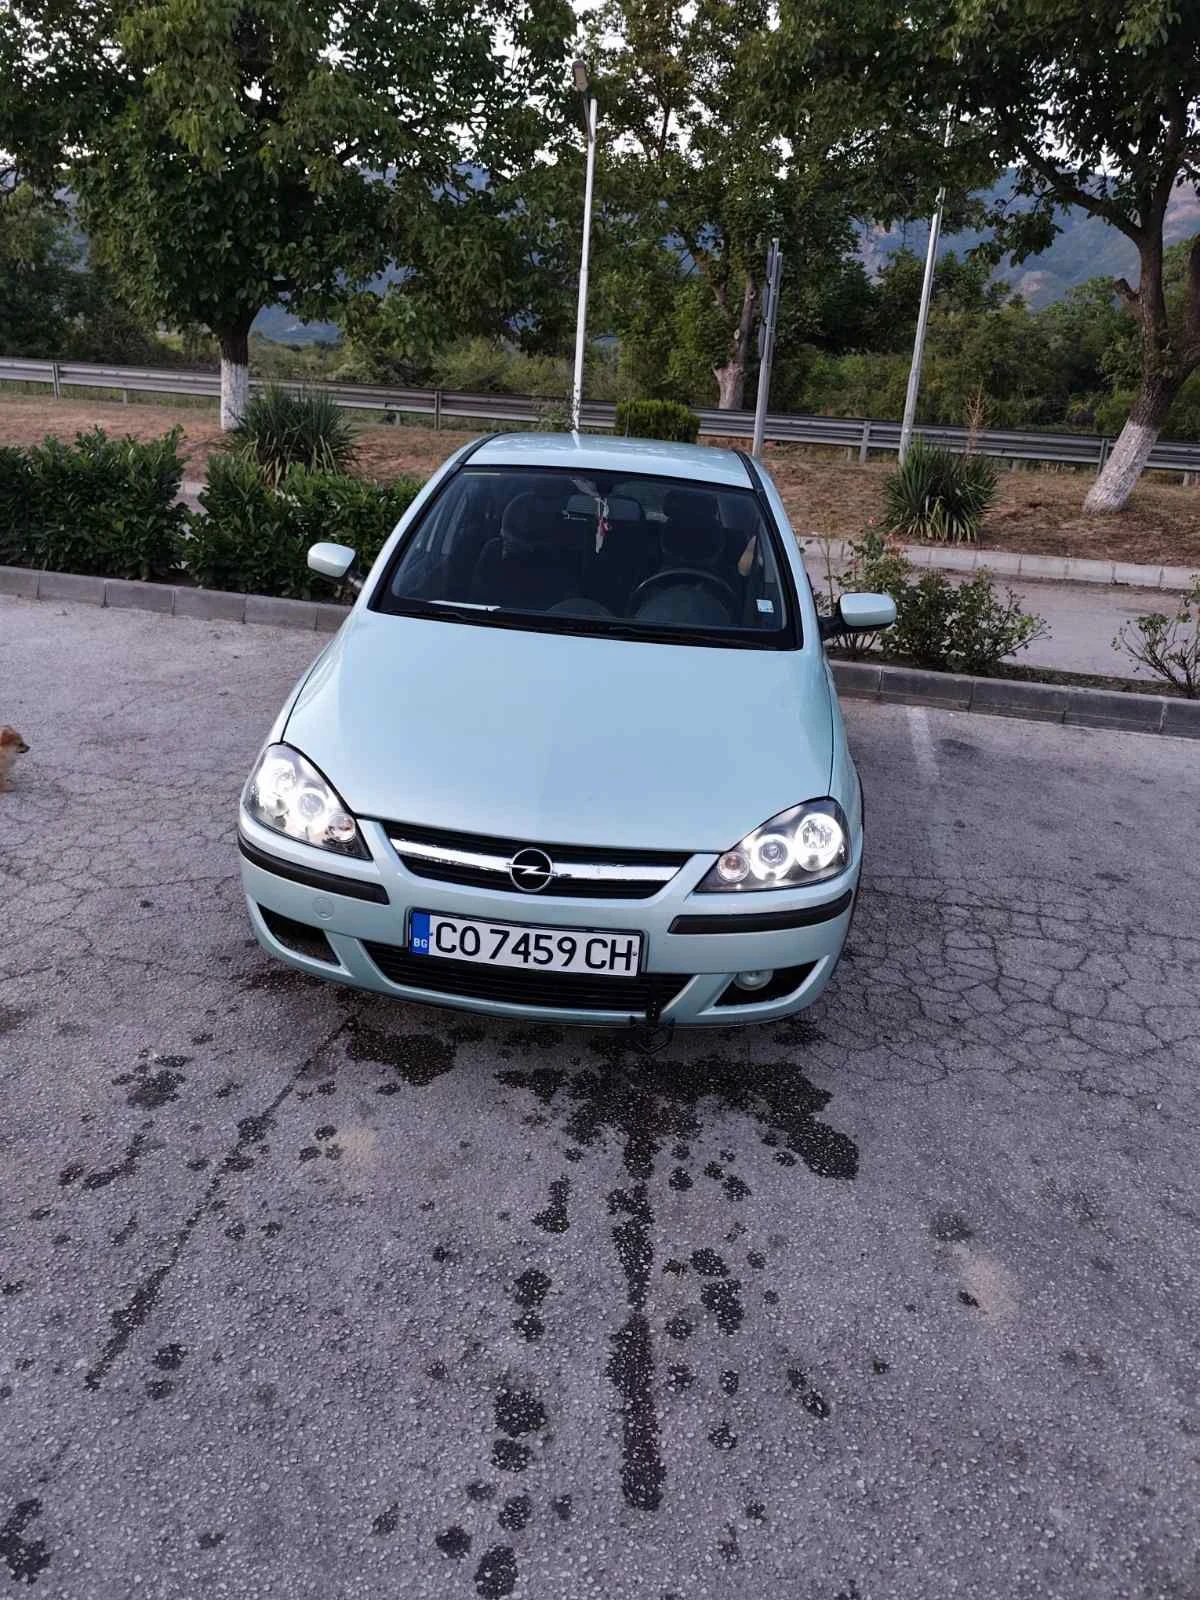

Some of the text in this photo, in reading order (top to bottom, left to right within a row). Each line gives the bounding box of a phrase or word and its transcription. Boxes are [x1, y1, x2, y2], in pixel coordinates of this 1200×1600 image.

[413, 937, 428, 948] BG
[488, 928, 577, 966] 7459
[585, 938, 633, 971] CH
